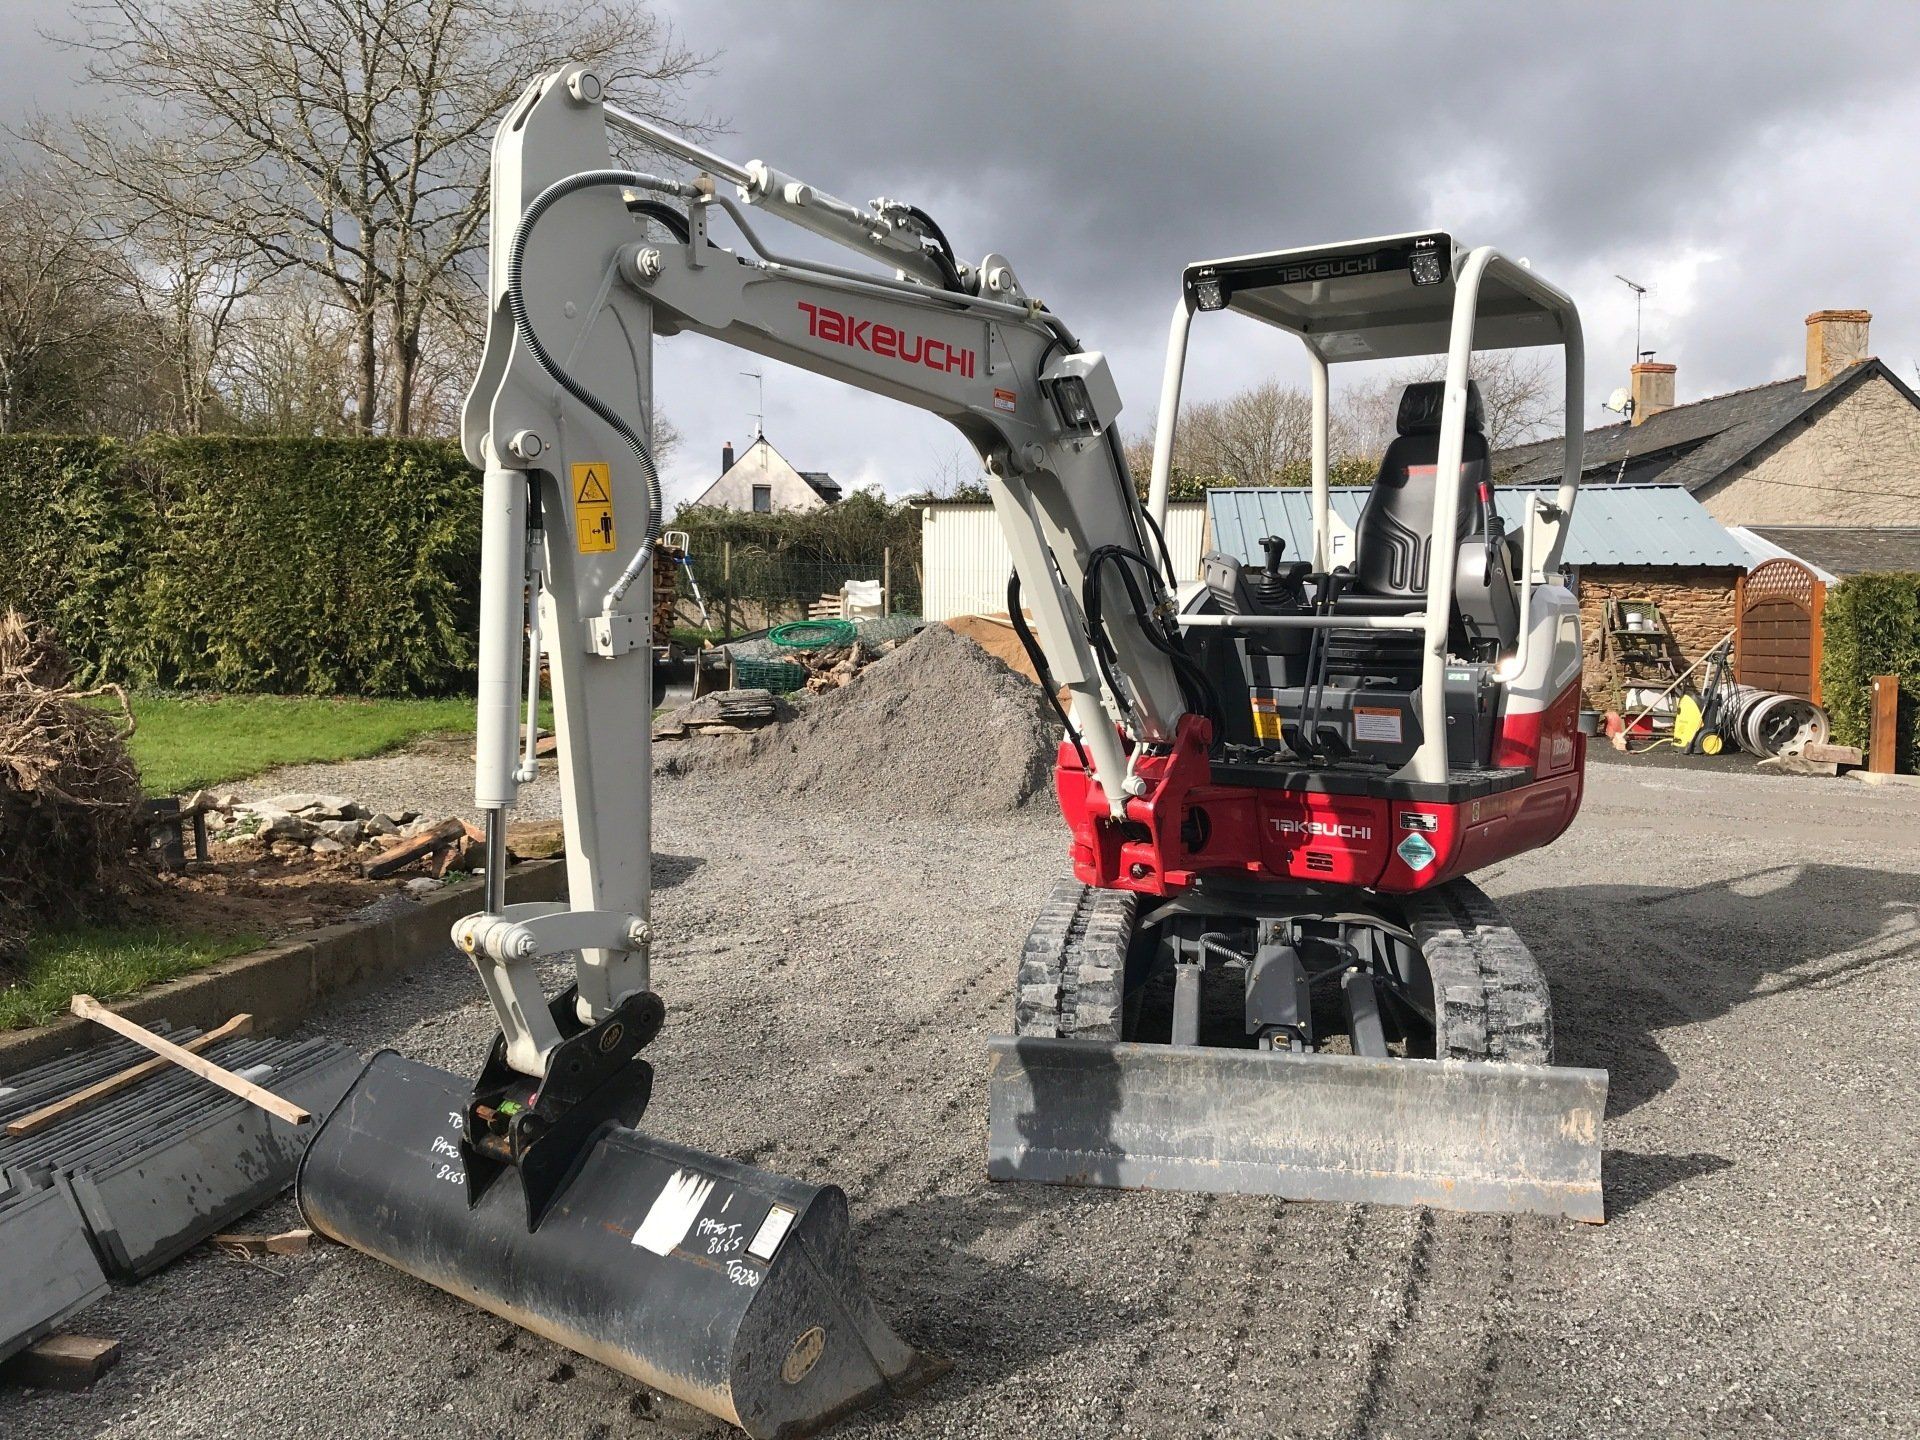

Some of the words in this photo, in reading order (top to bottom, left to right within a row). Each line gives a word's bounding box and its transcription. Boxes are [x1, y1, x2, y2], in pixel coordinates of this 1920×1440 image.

[1277, 258, 1377, 282] TAKEUCHI
[797, 301, 975, 379] TAKEUCHI
[1333, 535, 1346, 554] F
[1269, 818, 1372, 840] TAKEUCHI
[707, 1236, 743, 1255] 8665
